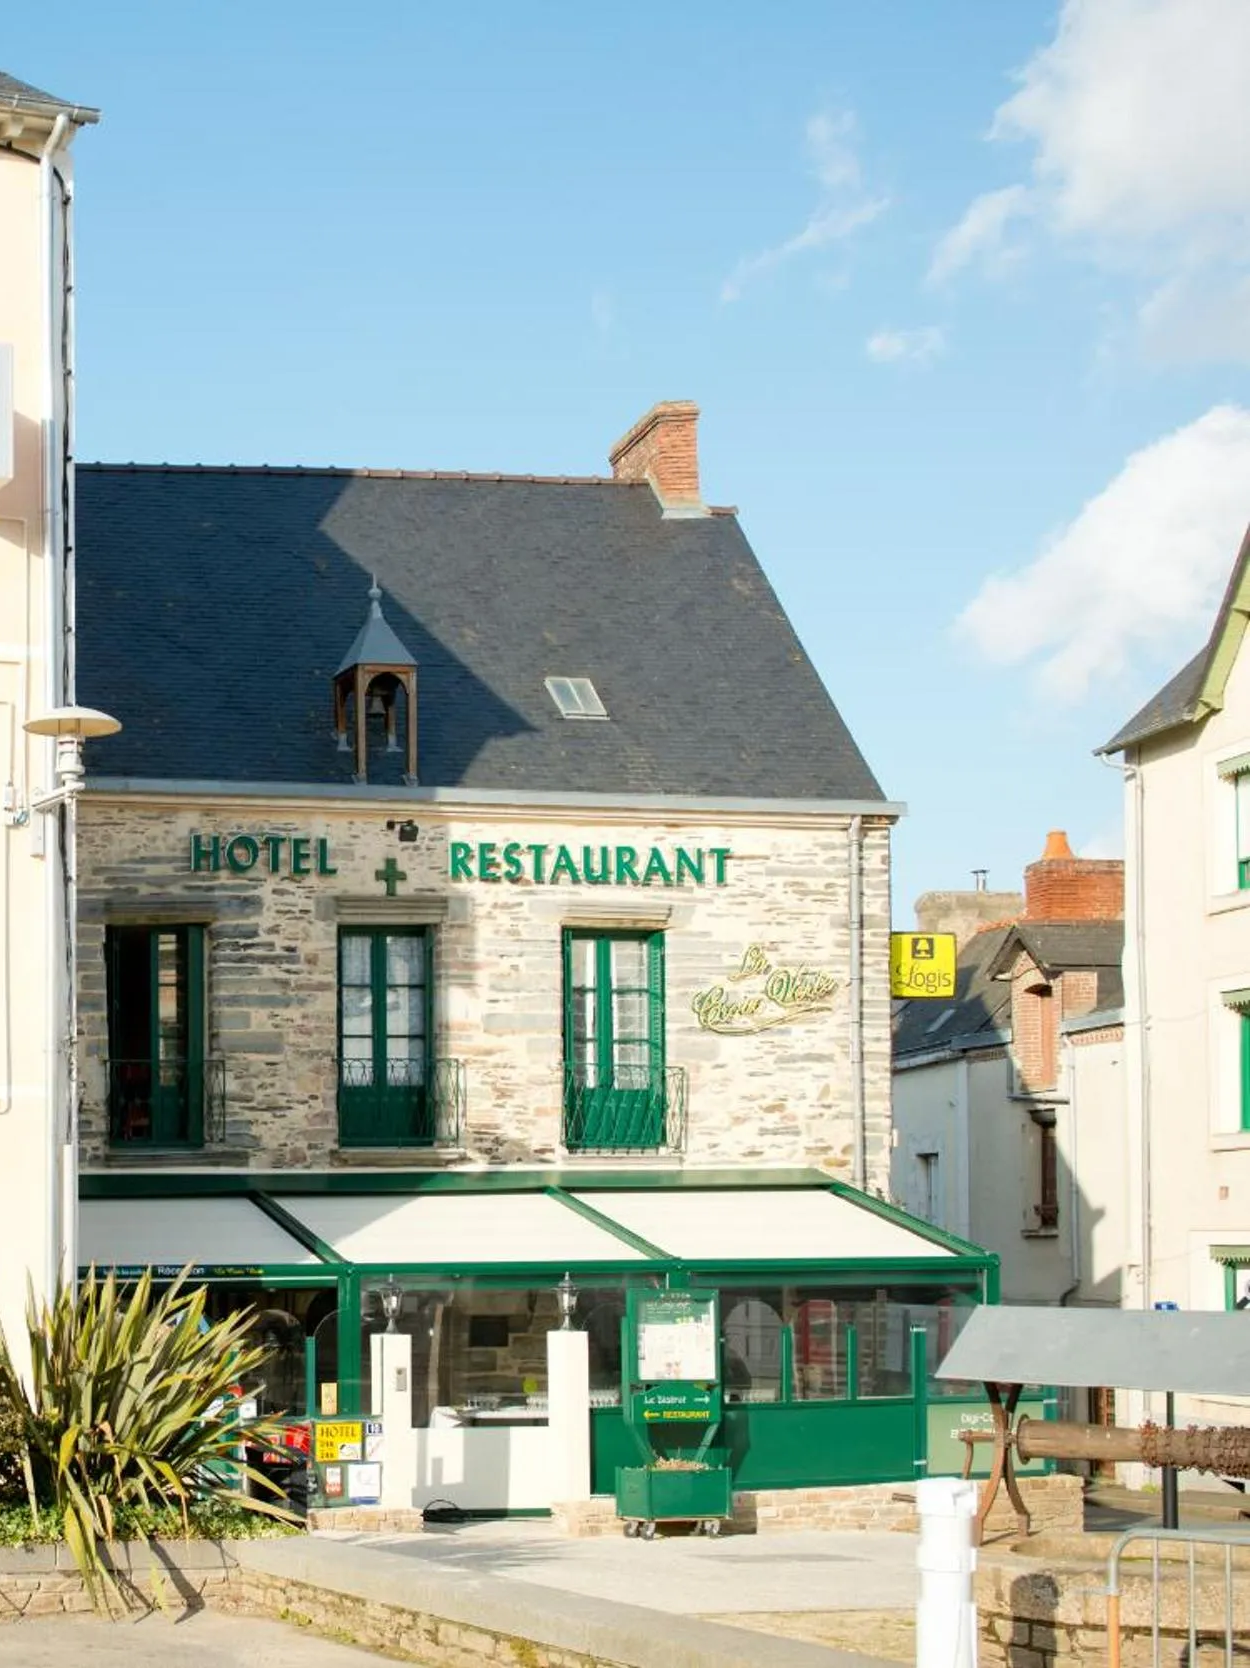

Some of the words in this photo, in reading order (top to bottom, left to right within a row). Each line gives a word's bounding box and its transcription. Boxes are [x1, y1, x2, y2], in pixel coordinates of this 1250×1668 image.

[189, 832, 338, 876] HOTEL
[449, 841, 731, 886] RESTAURANT
[893, 963, 952, 993] Logis
[320, 1426, 357, 1438] HOTEL
